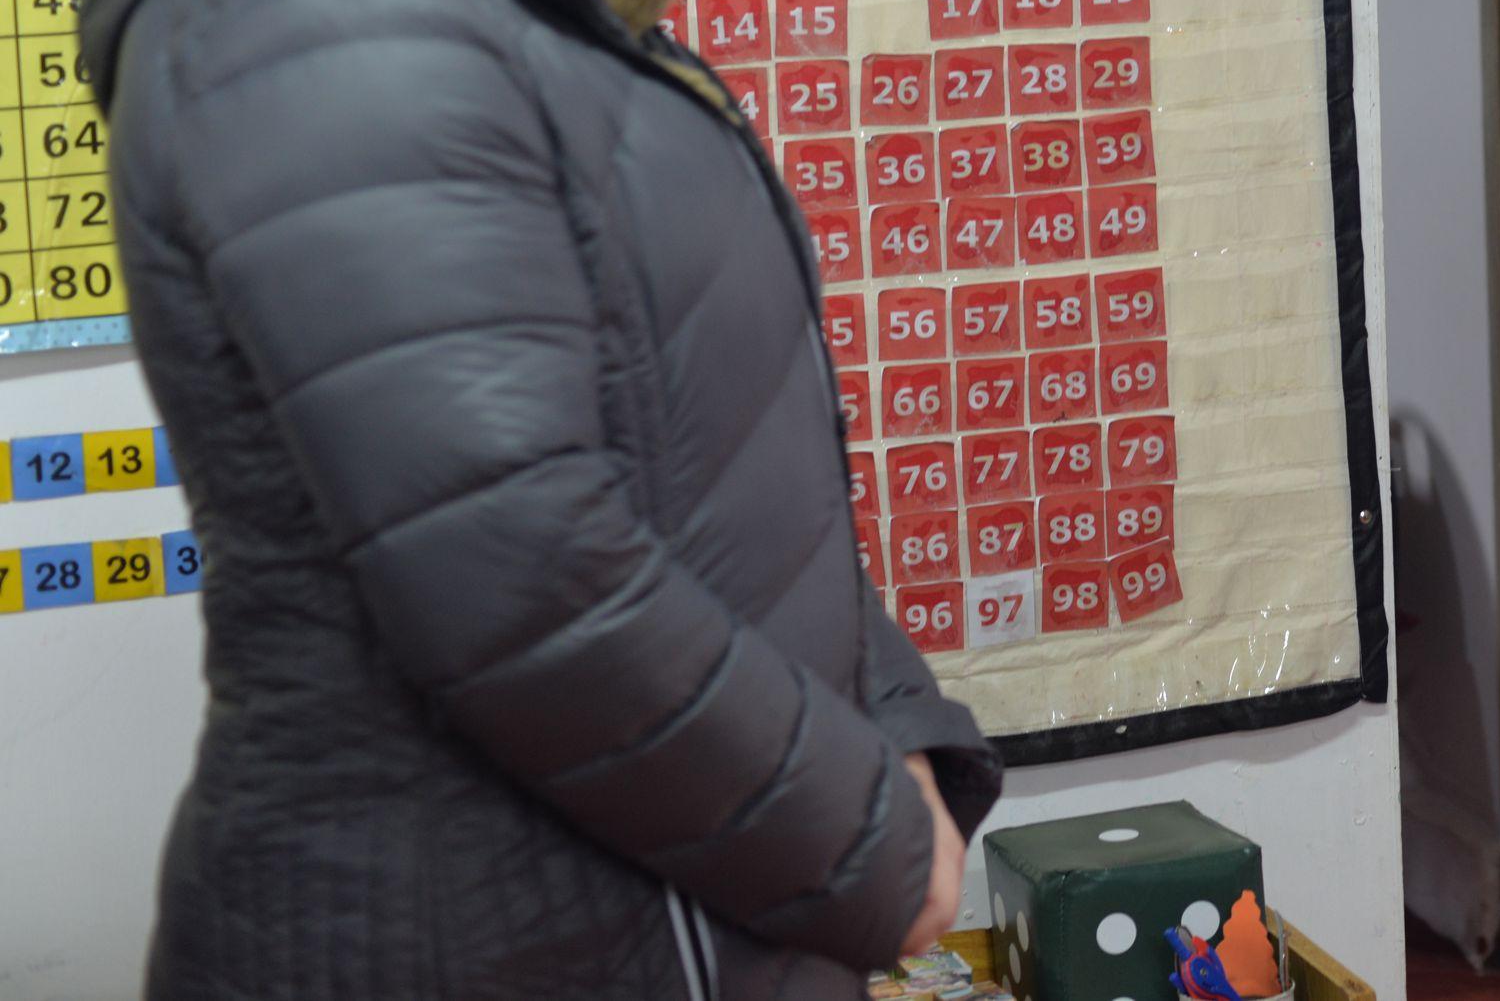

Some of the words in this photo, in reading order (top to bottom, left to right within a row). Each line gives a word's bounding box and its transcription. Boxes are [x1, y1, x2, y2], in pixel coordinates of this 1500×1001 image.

[711, 13, 758, 45] 14
[790, 6, 835, 37] 15
[739, 91, 760, 120] 4
[790, 82, 837, 113] 25
[873, 76, 919, 104] 26
[948, 69, 992, 98] 27
[1022, 64, 1066, 94] 28
[1094, 58, 1139, 87] 29
[43, 121, 105, 159] 64
[796, 161, 844, 191] 35
[879, 154, 925, 185] 36
[951, 147, 996, 178] 37
[1024, 141, 1069, 171] 38
[1096, 133, 1141, 164] 39
[47, 191, 109, 229] 72
[881, 225, 929, 254] 46
[957, 219, 1003, 247] 47
[1028, 214, 1074, 243] 48
[1100, 206, 1146, 235] 49
[50, 263, 112, 301] 80
[823, 317, 854, 347] 5
[890, 310, 936, 339] 56
[965, 304, 1008, 335] 57
[1037, 297, 1081, 328] 58
[1109, 291, 1153, 322] 59
[894, 386, 940, 416] 66
[968, 379, 1013, 409] 67
[1041, 372, 1086, 401] 68
[1112, 362, 1156, 392] 69
[26, 452, 72, 483] 12
[98, 445, 142, 476] 13
[900, 462, 947, 494] 76
[974, 452, 1018, 483] 77
[1045, 444, 1091, 474] 78
[1120, 436, 1163, 467] 79
[902, 533, 948, 565] 86
[980, 523, 1023, 555] 87
[1050, 514, 1095, 543] 88
[1118, 506, 1162, 536] 89
[35, 560, 81, 593] 28
[106, 553, 151, 585] 29
[176, 546, 207, 576] 3
[906, 602, 952, 633] 96
[978, 594, 1024, 627] 97
[1053, 582, 1098, 611] 98
[1123, 563, 1166, 600] 99
